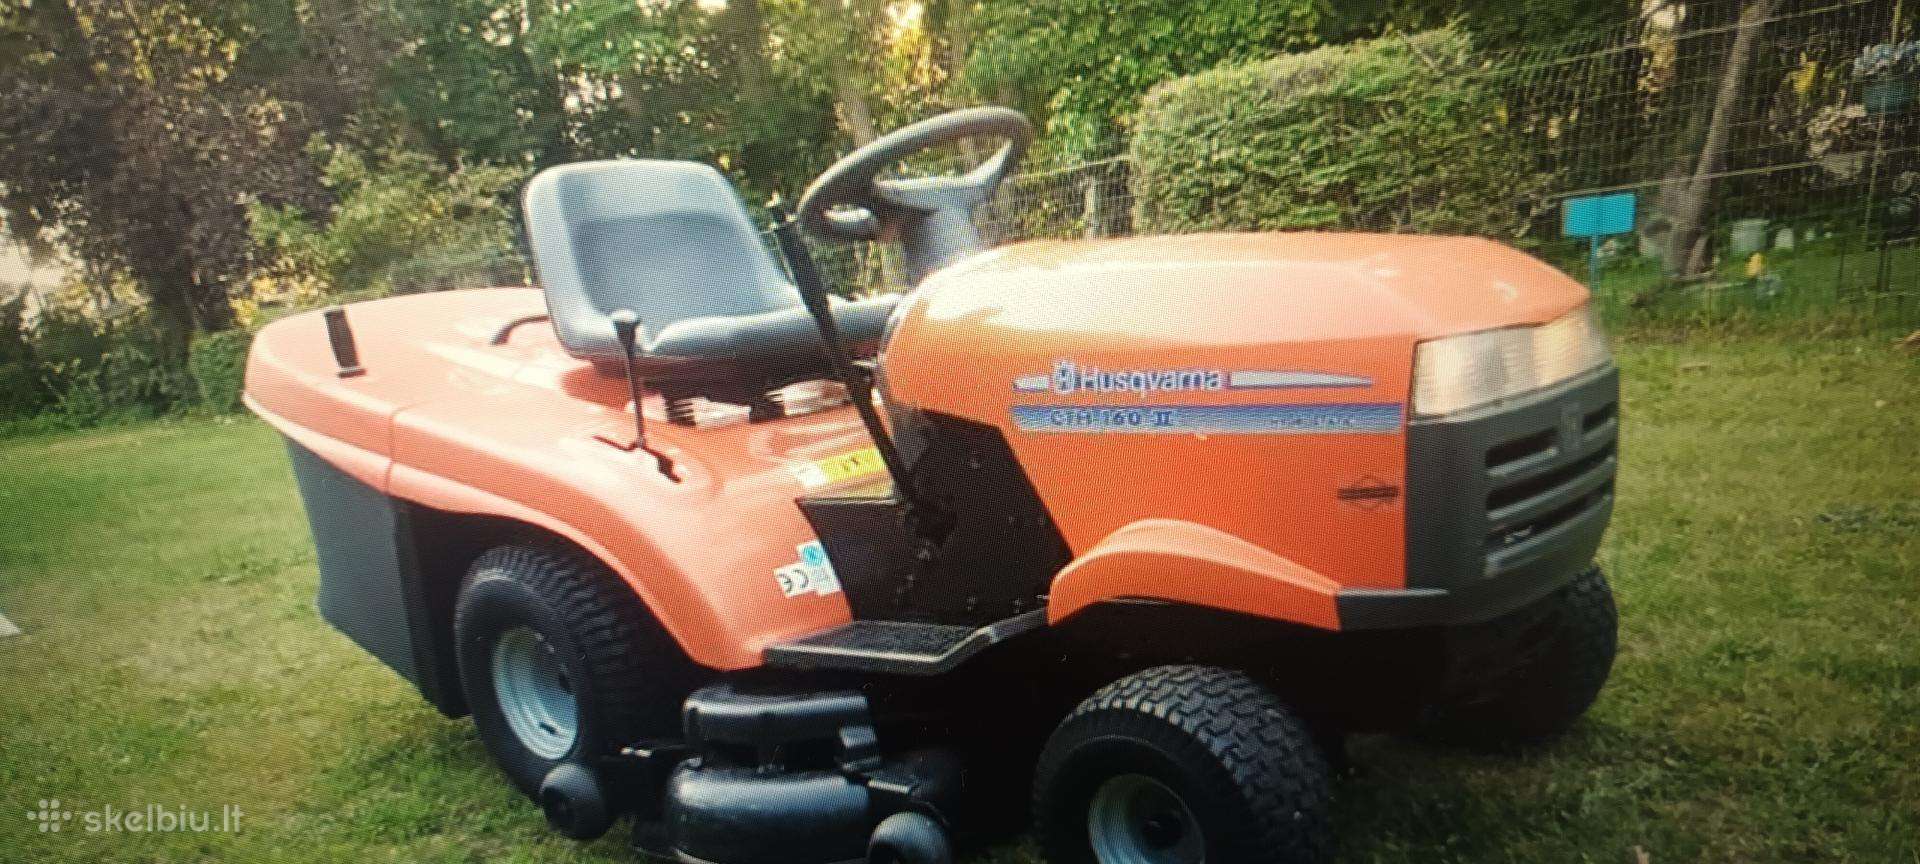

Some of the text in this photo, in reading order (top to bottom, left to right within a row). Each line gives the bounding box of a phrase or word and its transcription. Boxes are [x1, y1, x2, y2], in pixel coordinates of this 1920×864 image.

[1081, 367, 1222, 398] Husqvarna
[1051, 411, 1092, 426] CTH
[1103, 411, 1142, 426] 160
